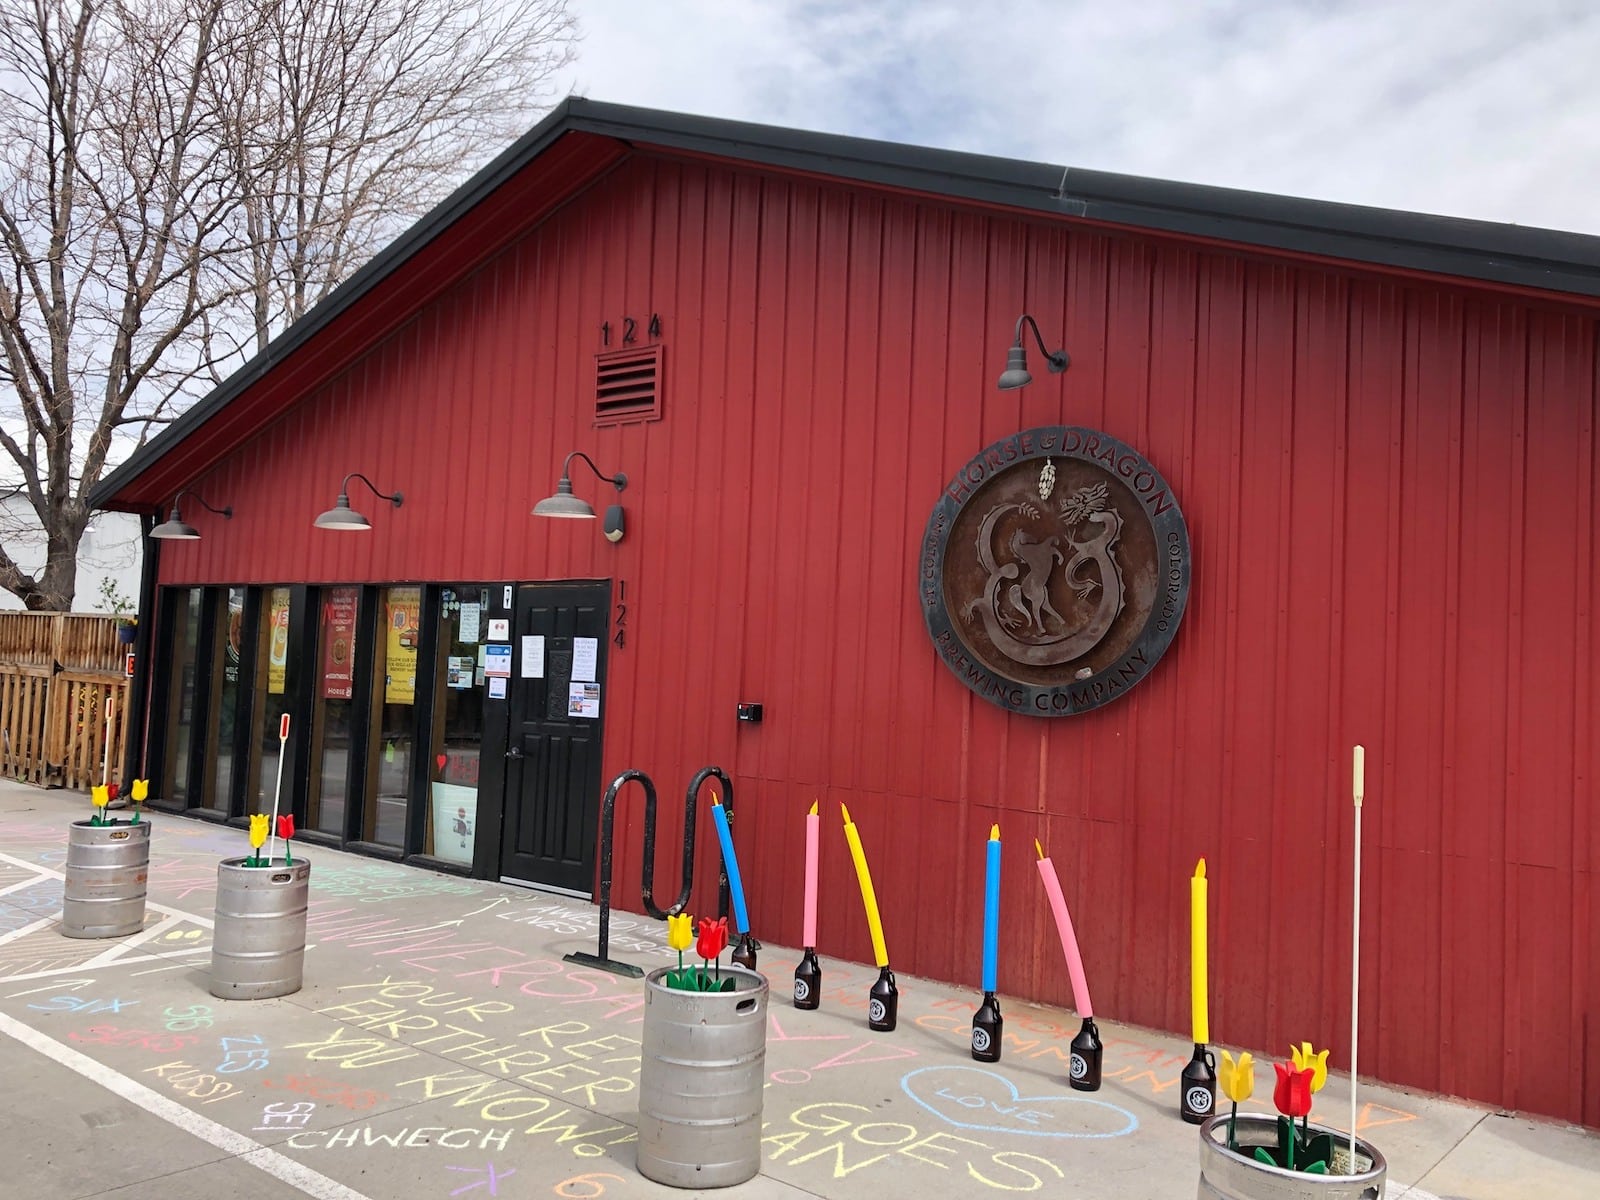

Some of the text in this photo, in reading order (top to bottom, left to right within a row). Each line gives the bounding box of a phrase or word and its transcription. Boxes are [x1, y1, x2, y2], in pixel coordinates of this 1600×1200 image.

[601, 313, 661, 346] 124
[947, 434, 1034, 504] HORSE
[1062, 431, 1174, 518] DRAGON
[614, 580, 628, 650] 124
[1157, 531, 1182, 632] COLORADO
[935, 630, 1149, 711] BREWING COMPANY
[283, 1027, 420, 1069] YOU
[336, 975, 514, 1022] YOUR
[790, 1103, 1065, 1191] GOES
[286, 1126, 515, 1152] CHWECH
[934, 1087, 1055, 1125] LOVE
